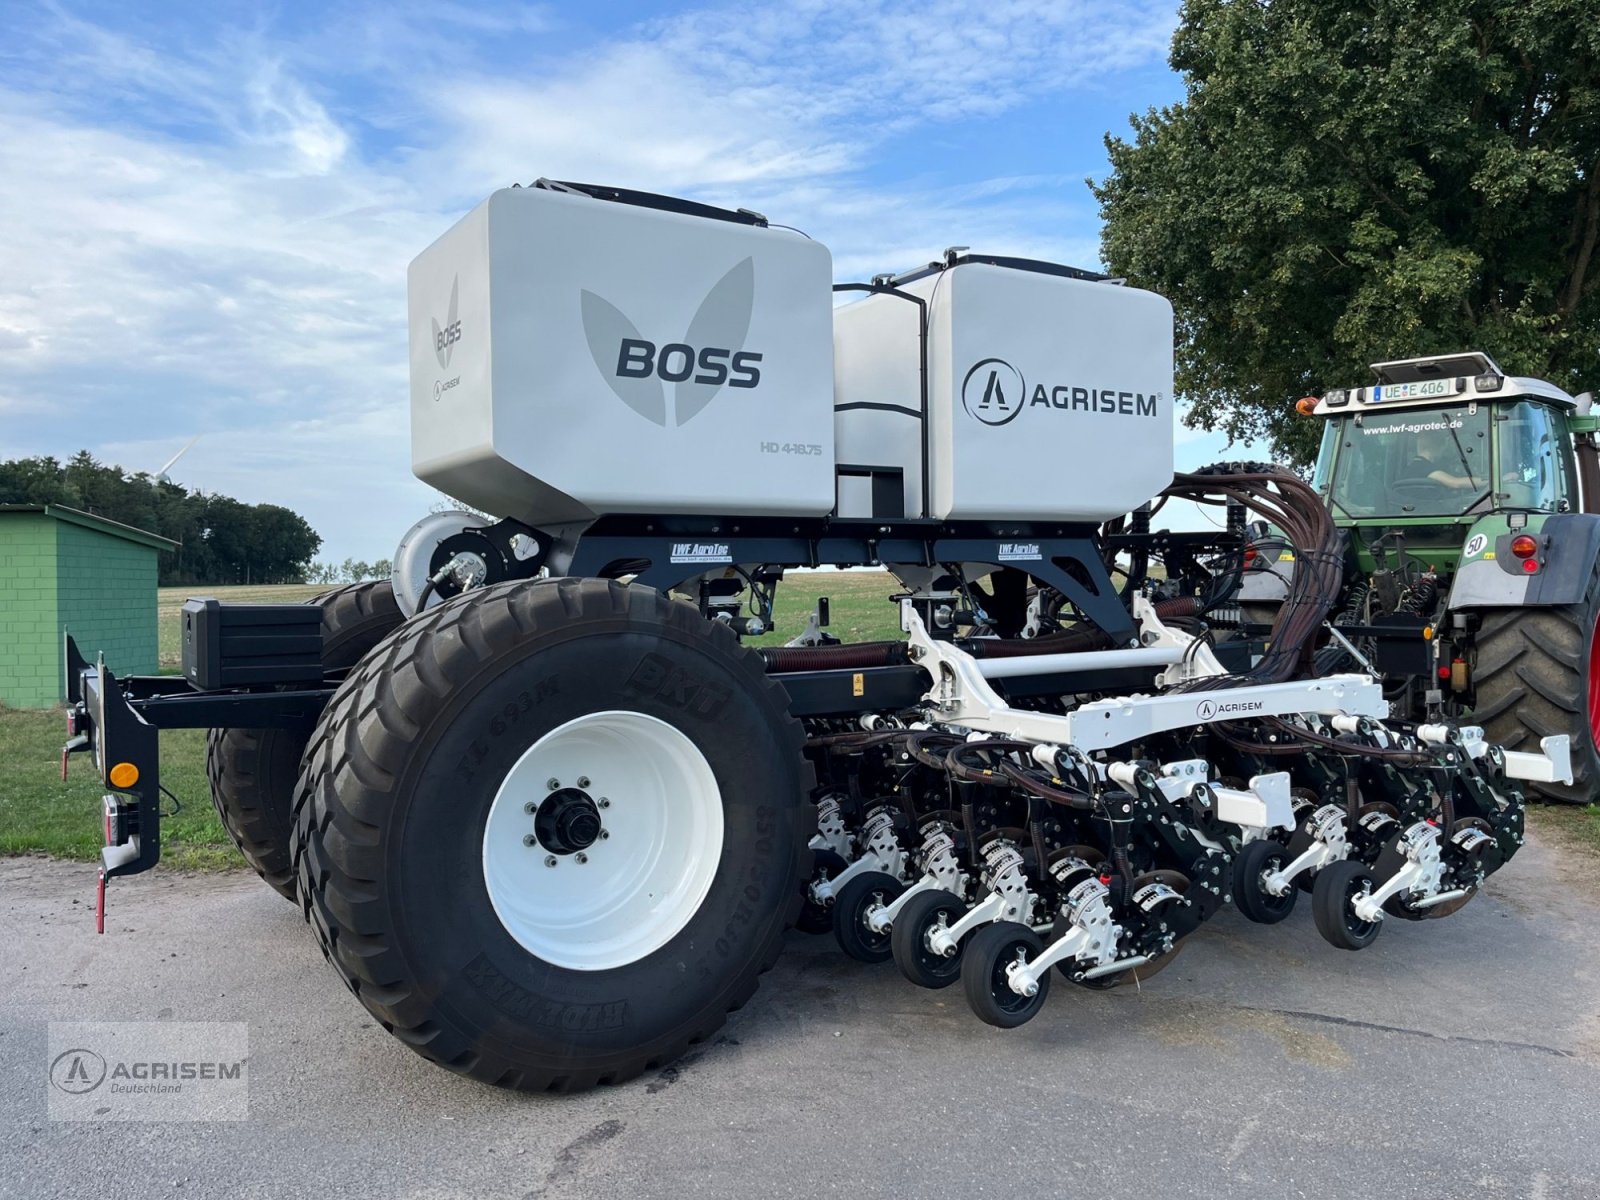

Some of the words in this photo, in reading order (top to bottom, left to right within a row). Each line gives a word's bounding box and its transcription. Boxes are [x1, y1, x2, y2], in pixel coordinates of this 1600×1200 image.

[437, 320, 461, 352] BOSS
[616, 338, 763, 389] BOSS
[1385, 386, 1401, 399] UE
[1409, 384, 1417, 396] E
[1420, 382, 1444, 395] 406
[760, 442, 779, 453] HD
[671, 544, 692, 556] LWF
[1467, 536, 1483, 555] 50
[627, 654, 731, 718] BKT
